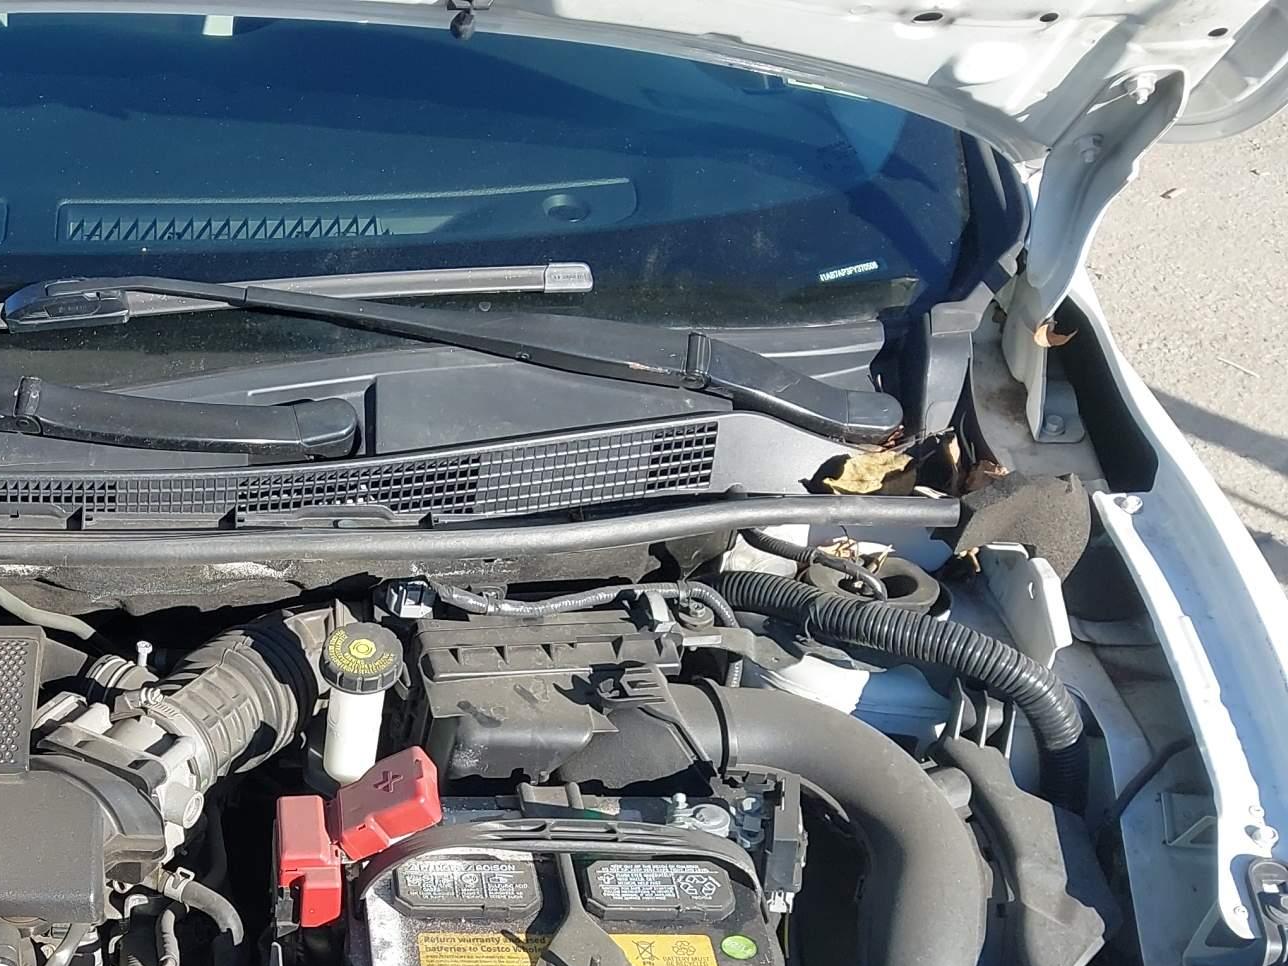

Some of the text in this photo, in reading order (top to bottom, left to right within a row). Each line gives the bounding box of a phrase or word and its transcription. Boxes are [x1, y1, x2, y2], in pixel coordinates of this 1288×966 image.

[458, 936, 500, 945] warranty
[425, 945, 467, 953] batteries
[469, 945, 479, 953] to
[481, 945, 510, 953] Costco
